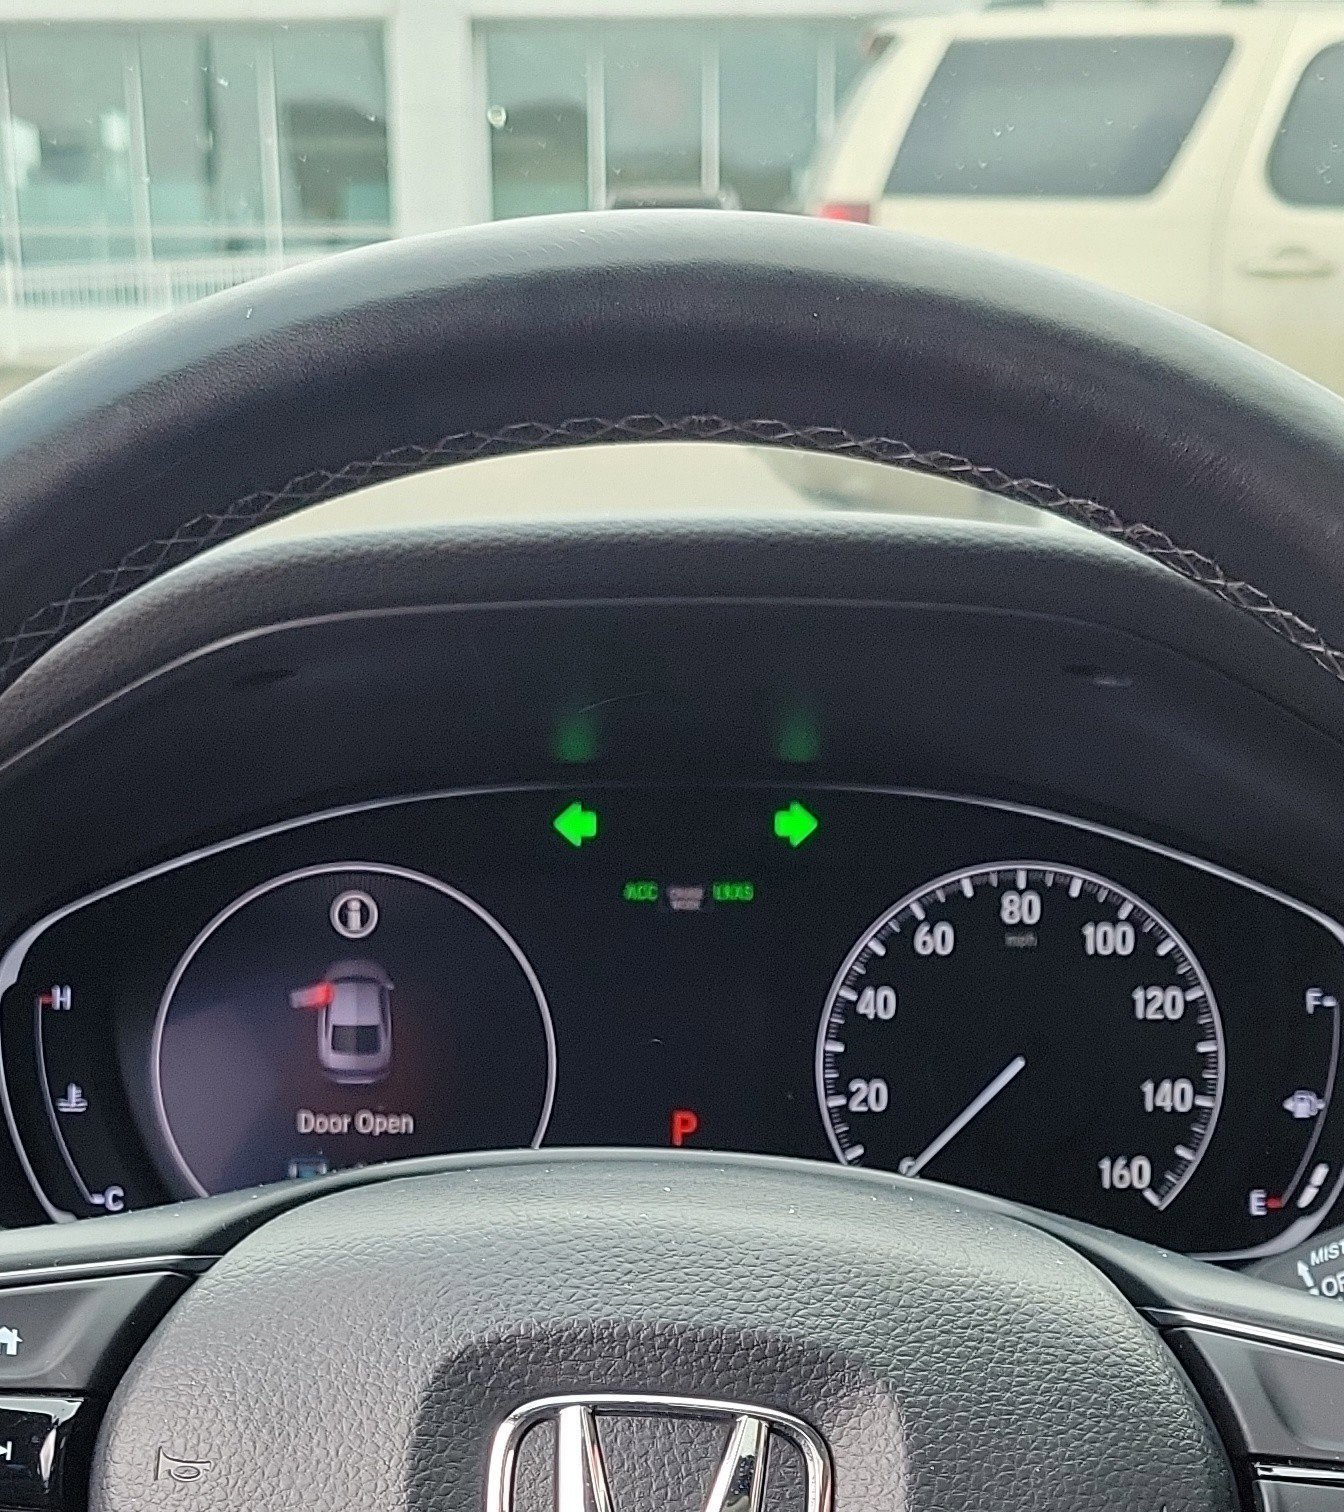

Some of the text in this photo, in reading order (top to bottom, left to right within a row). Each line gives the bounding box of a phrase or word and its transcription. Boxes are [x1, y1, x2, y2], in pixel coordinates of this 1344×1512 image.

[1000, 891, 1041, 925] 80
[914, 921, 954, 955] 60
[1082, 920, 1135, 955] 100
[53, 985, 71, 1011] H
[856, 985, 897, 1020] 40
[1133, 985, 1185, 1020] 120
[1306, 987, 1323, 1013] F
[848, 1078, 889, 1113] 20
[1141, 1077, 1194, 1112] 140
[297, 1109, 414, 1136] Door Open
[672, 1111, 698, 1145] P
[1098, 1156, 1152, 1190] 160
[105, 1186, 125, 1212] C
[1249, 1189, 1268, 1216] E
